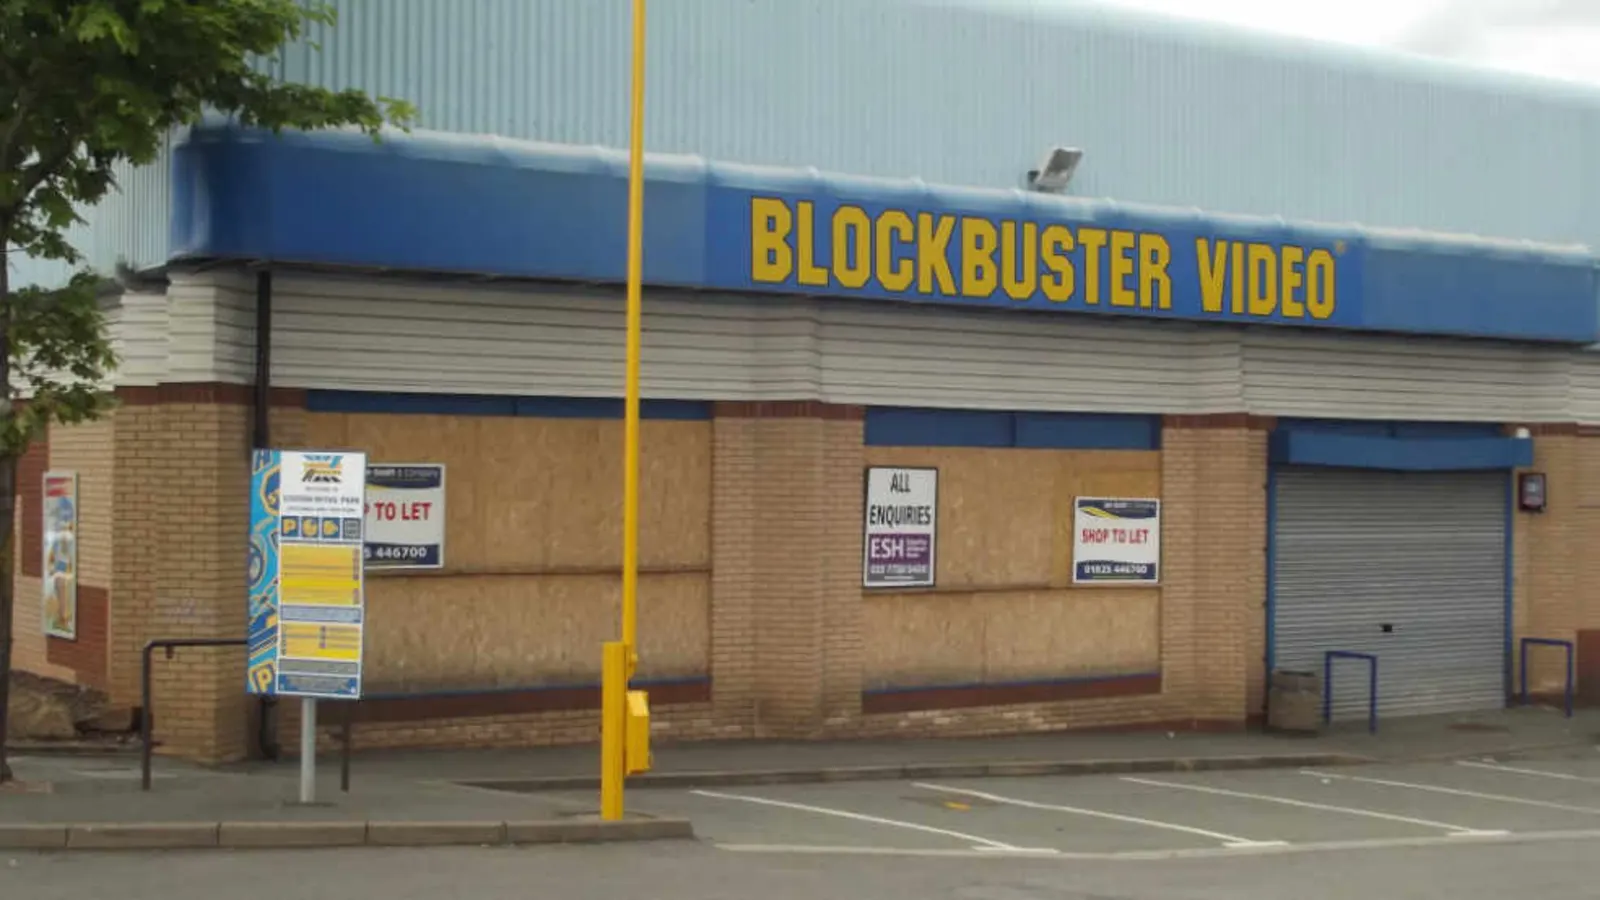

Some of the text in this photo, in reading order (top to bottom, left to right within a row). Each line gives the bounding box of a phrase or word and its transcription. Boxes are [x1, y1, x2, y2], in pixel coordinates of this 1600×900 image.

[751, 196, 1337, 320] BLOCKBUSTER VIDEO
[890, 473, 911, 493] ALL
[374, 502, 397, 521] TO
[401, 502, 433, 521] LET
[870, 504, 932, 528] ENQUIRIES
[1081, 528, 1149, 545] SHOP TO LET
[376, 546, 427, 560] 446700
[871, 538, 905, 558] ESH
